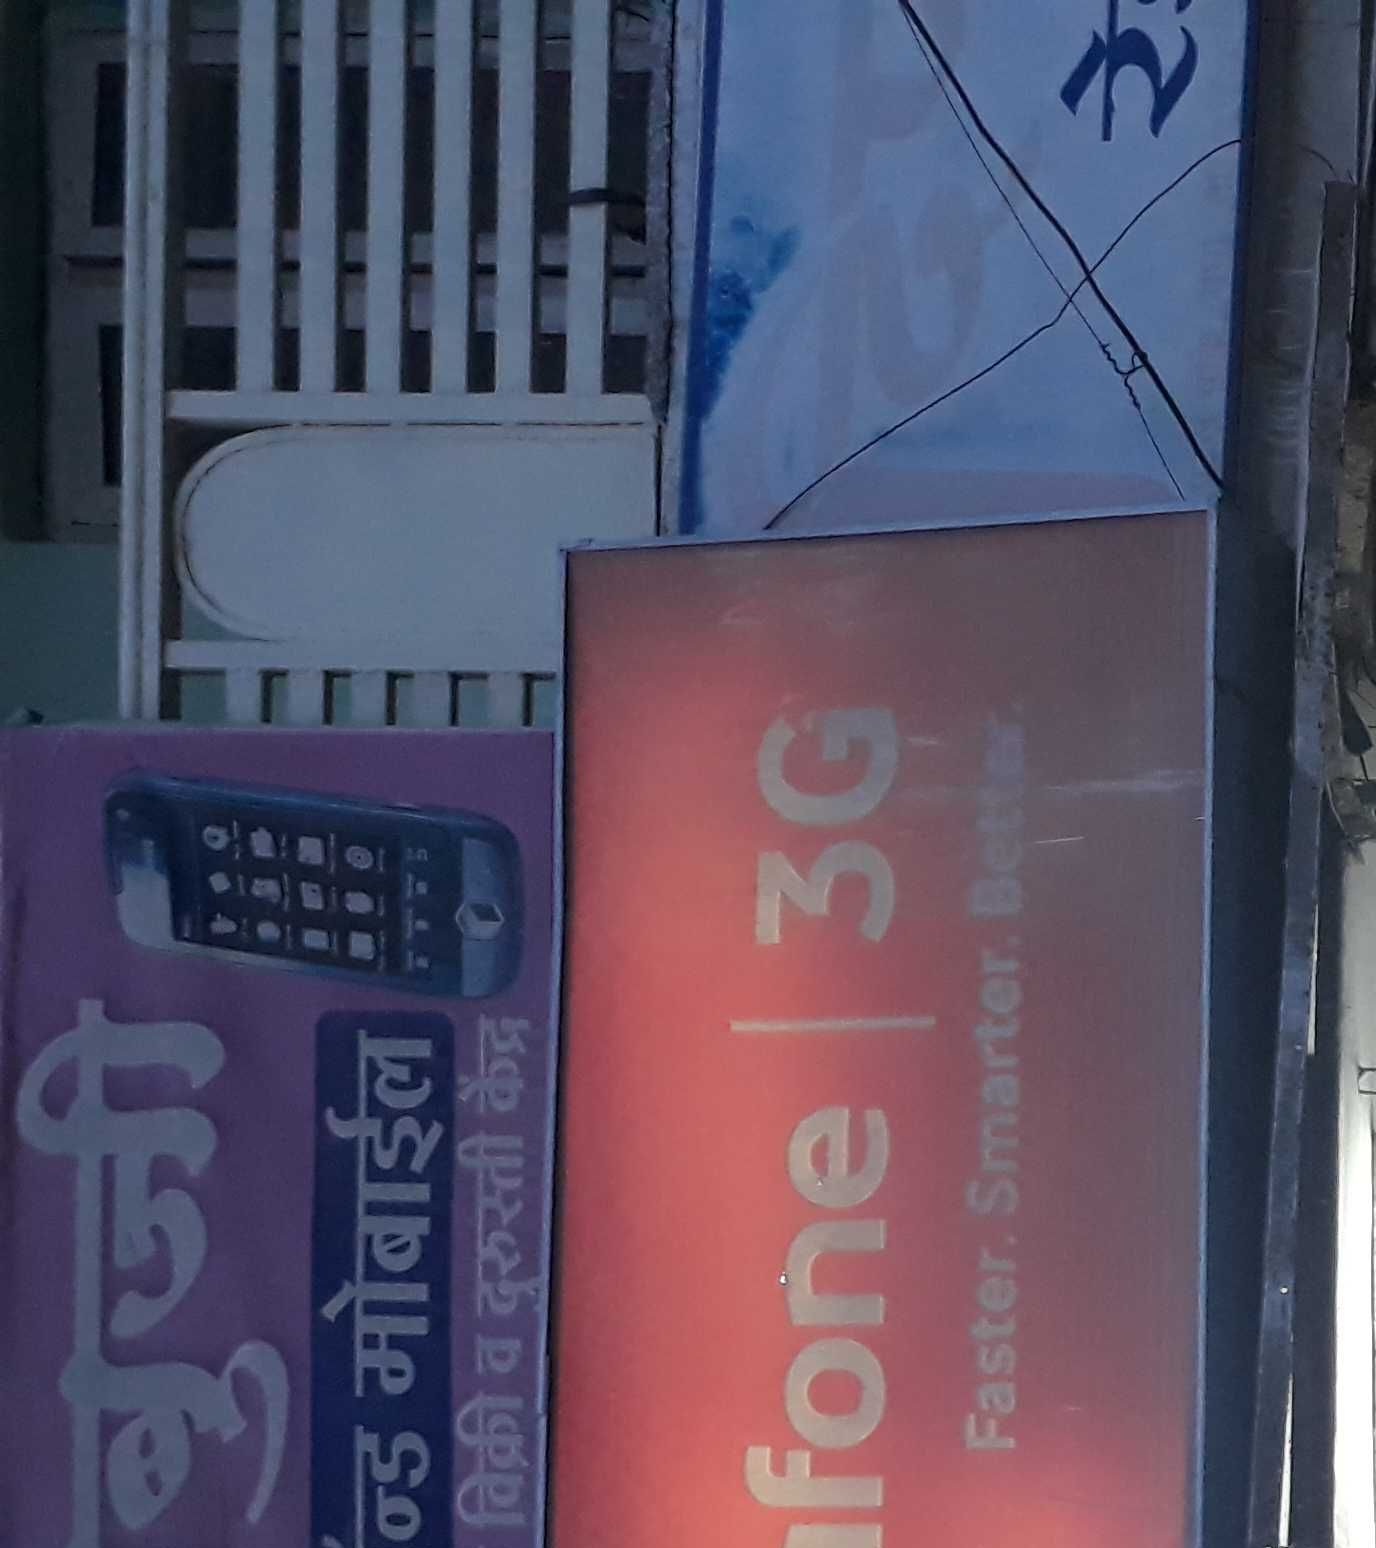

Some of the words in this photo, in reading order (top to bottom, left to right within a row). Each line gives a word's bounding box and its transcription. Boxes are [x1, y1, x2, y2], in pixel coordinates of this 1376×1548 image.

[756, 705, 900, 946] 3G
[457, 1013, 531, 1112] केंद्र
[321, 1028, 444, 1396] मोबाईल
[457, 1132, 540, 1316] दुरुस्ती
[474, 1337, 525, 1372] व
[457, 1389, 531, 1528] विक्री
